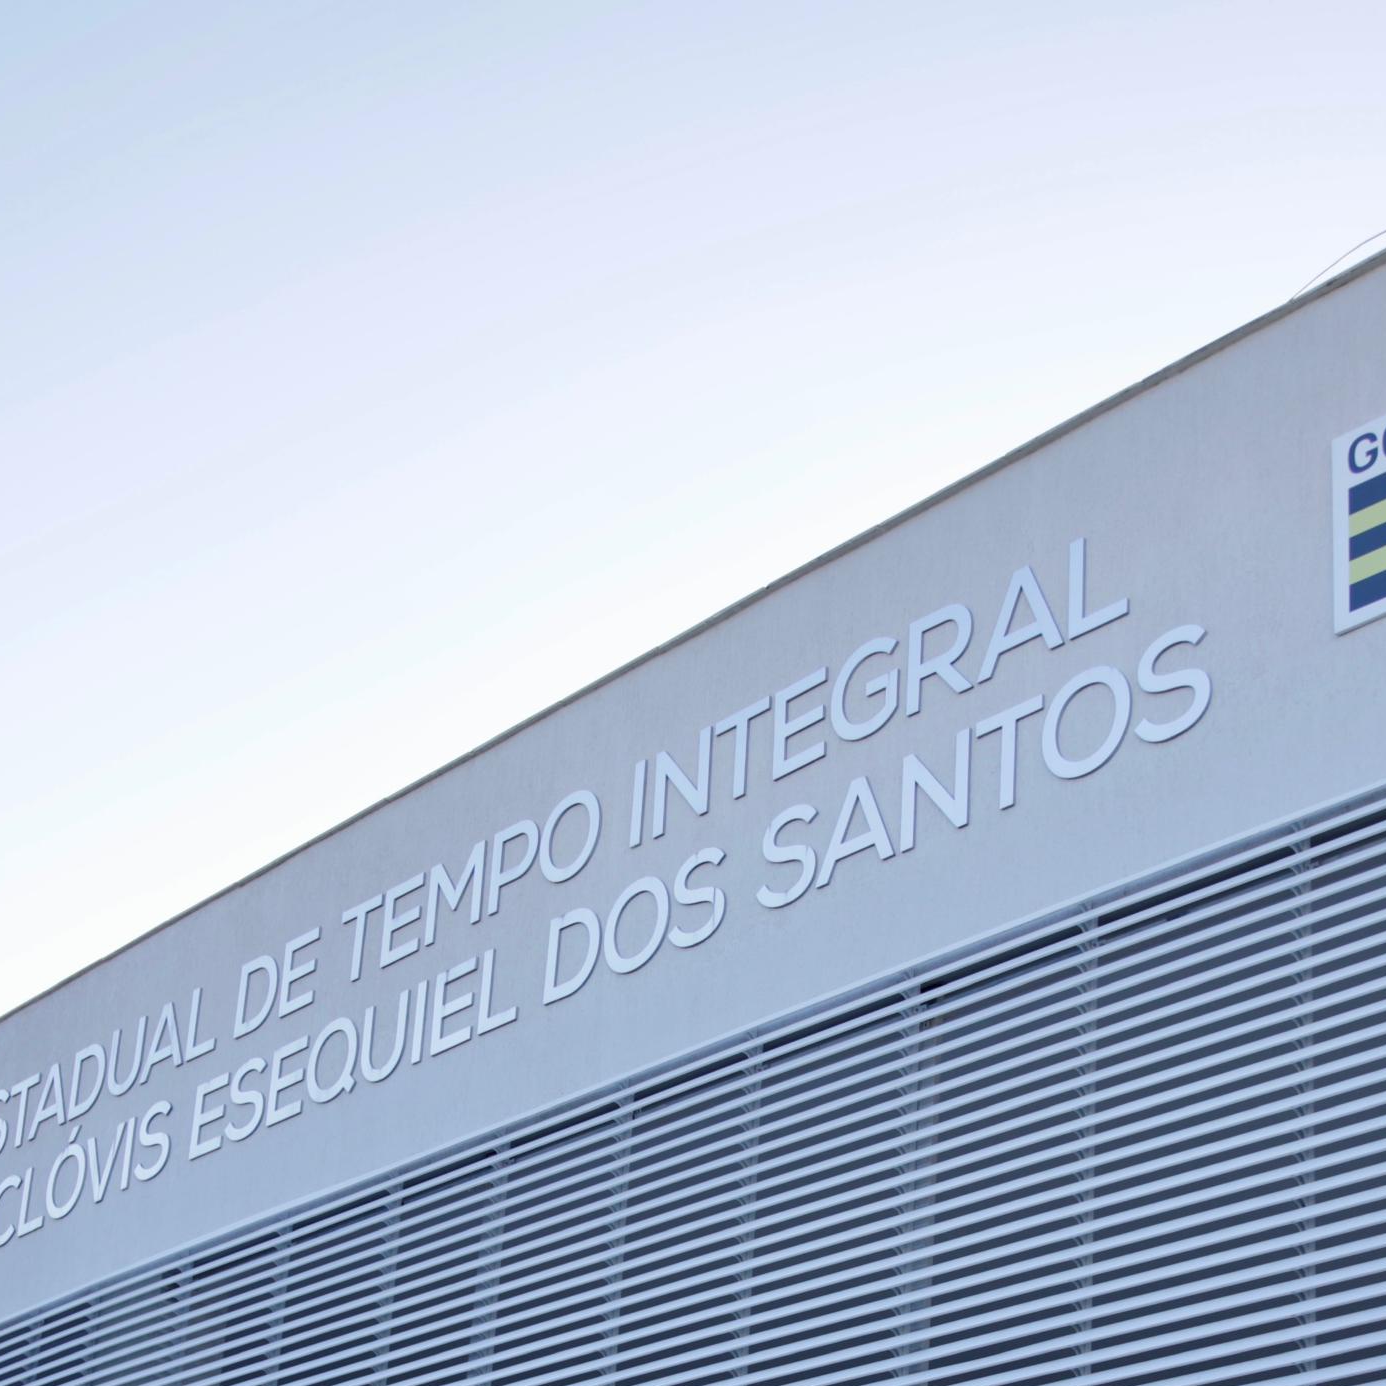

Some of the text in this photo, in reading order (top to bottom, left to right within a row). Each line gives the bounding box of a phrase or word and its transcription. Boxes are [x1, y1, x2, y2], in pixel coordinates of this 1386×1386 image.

[189, 948, 518, 1161] ESEQUIEL
[542, 847, 727, 1005] DOS
[756, 623, 1213, 910] SANTOS
[233, 926, 322, 1039] DE
[341, 790, 602, 982] TEMPO
[628, 537, 1130, 849] INTEGRAL
